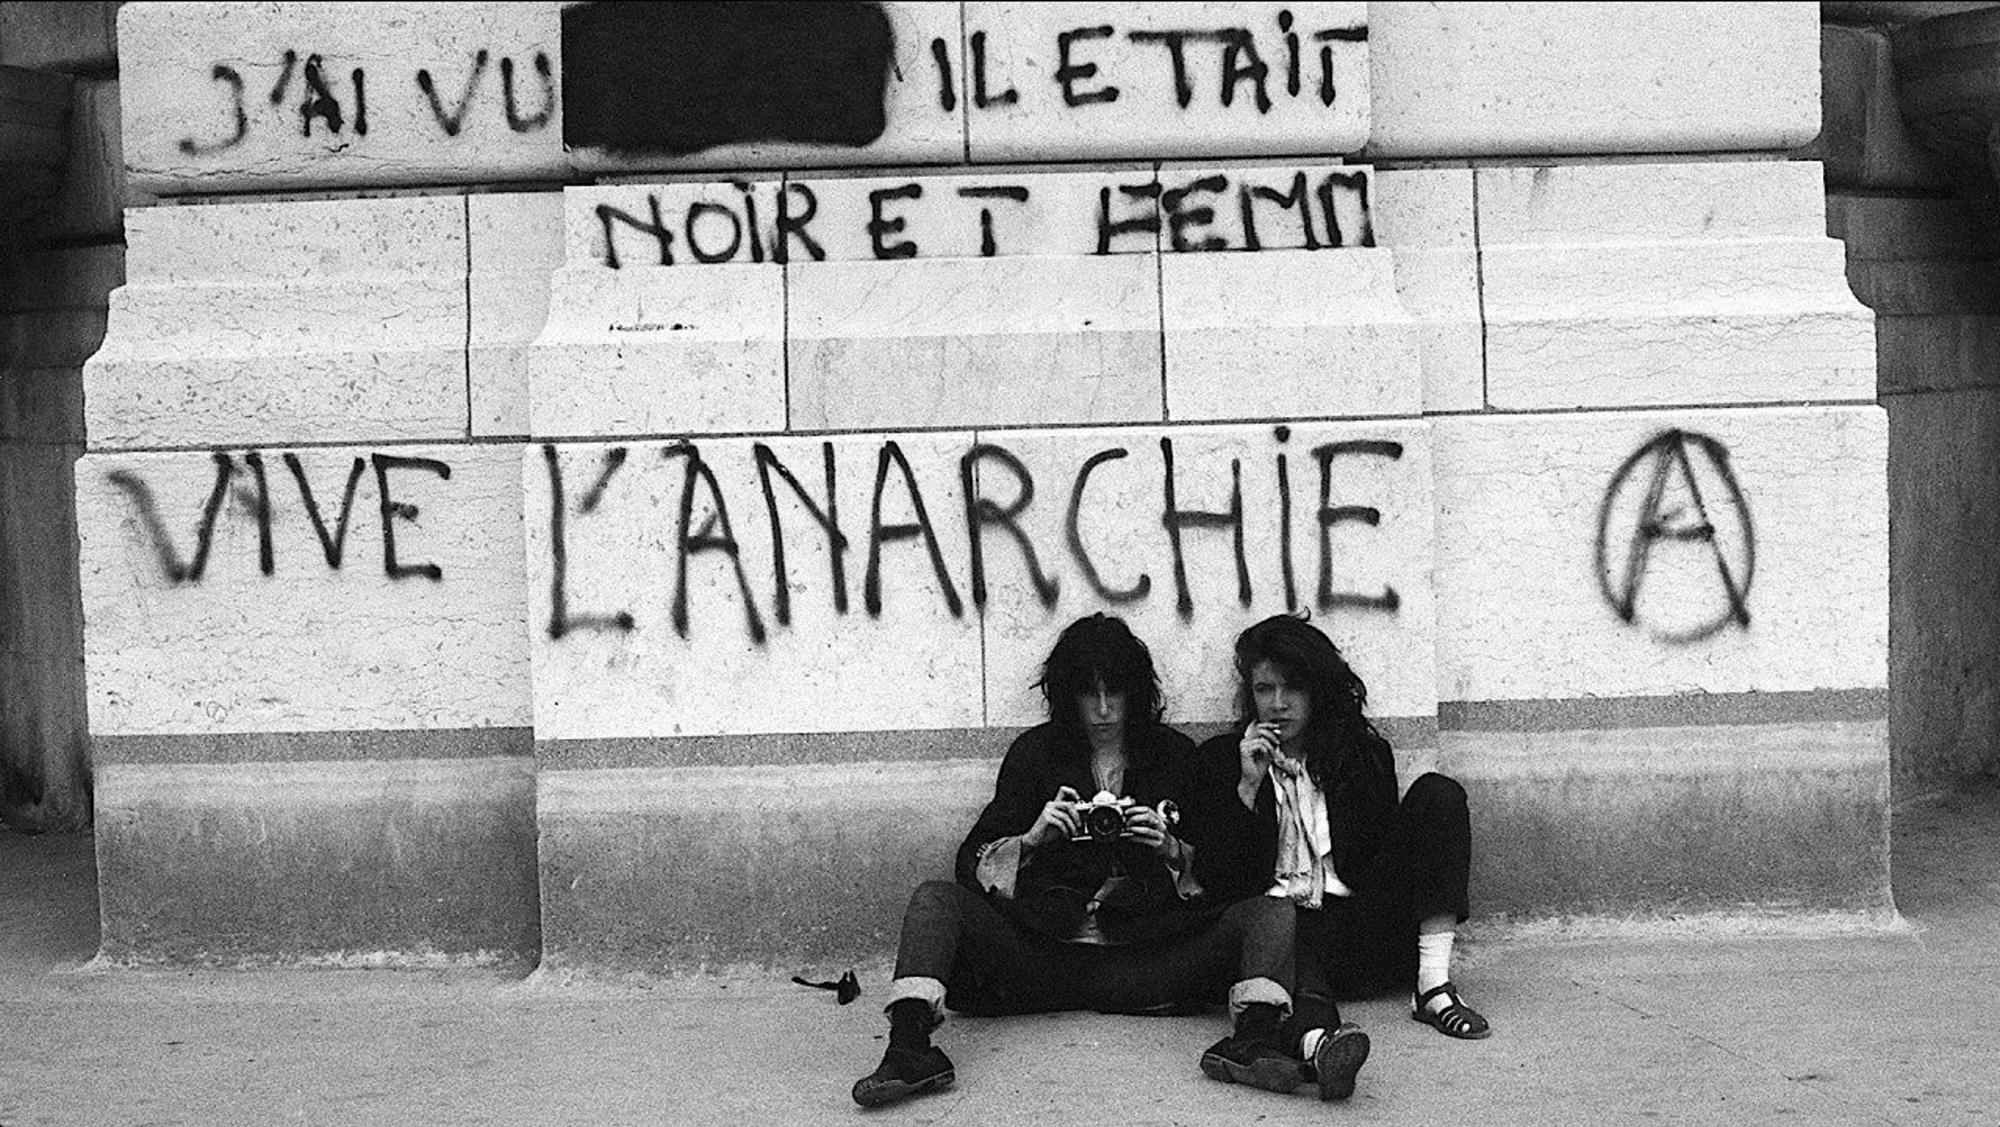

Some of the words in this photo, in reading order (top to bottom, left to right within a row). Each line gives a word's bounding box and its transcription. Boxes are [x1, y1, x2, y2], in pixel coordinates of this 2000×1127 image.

[178, 49, 368, 155] J'AI
[417, 49, 554, 136] VU
[931, 30, 1019, 112] IL
[1056, 9, 1369, 114] ETAIT
[596, 178, 826, 270] NOIR
[868, 182, 1029, 259] ET
[107, 449, 452, 587] VIVE
[543, 424, 1403, 645] L'ANARCHIE
